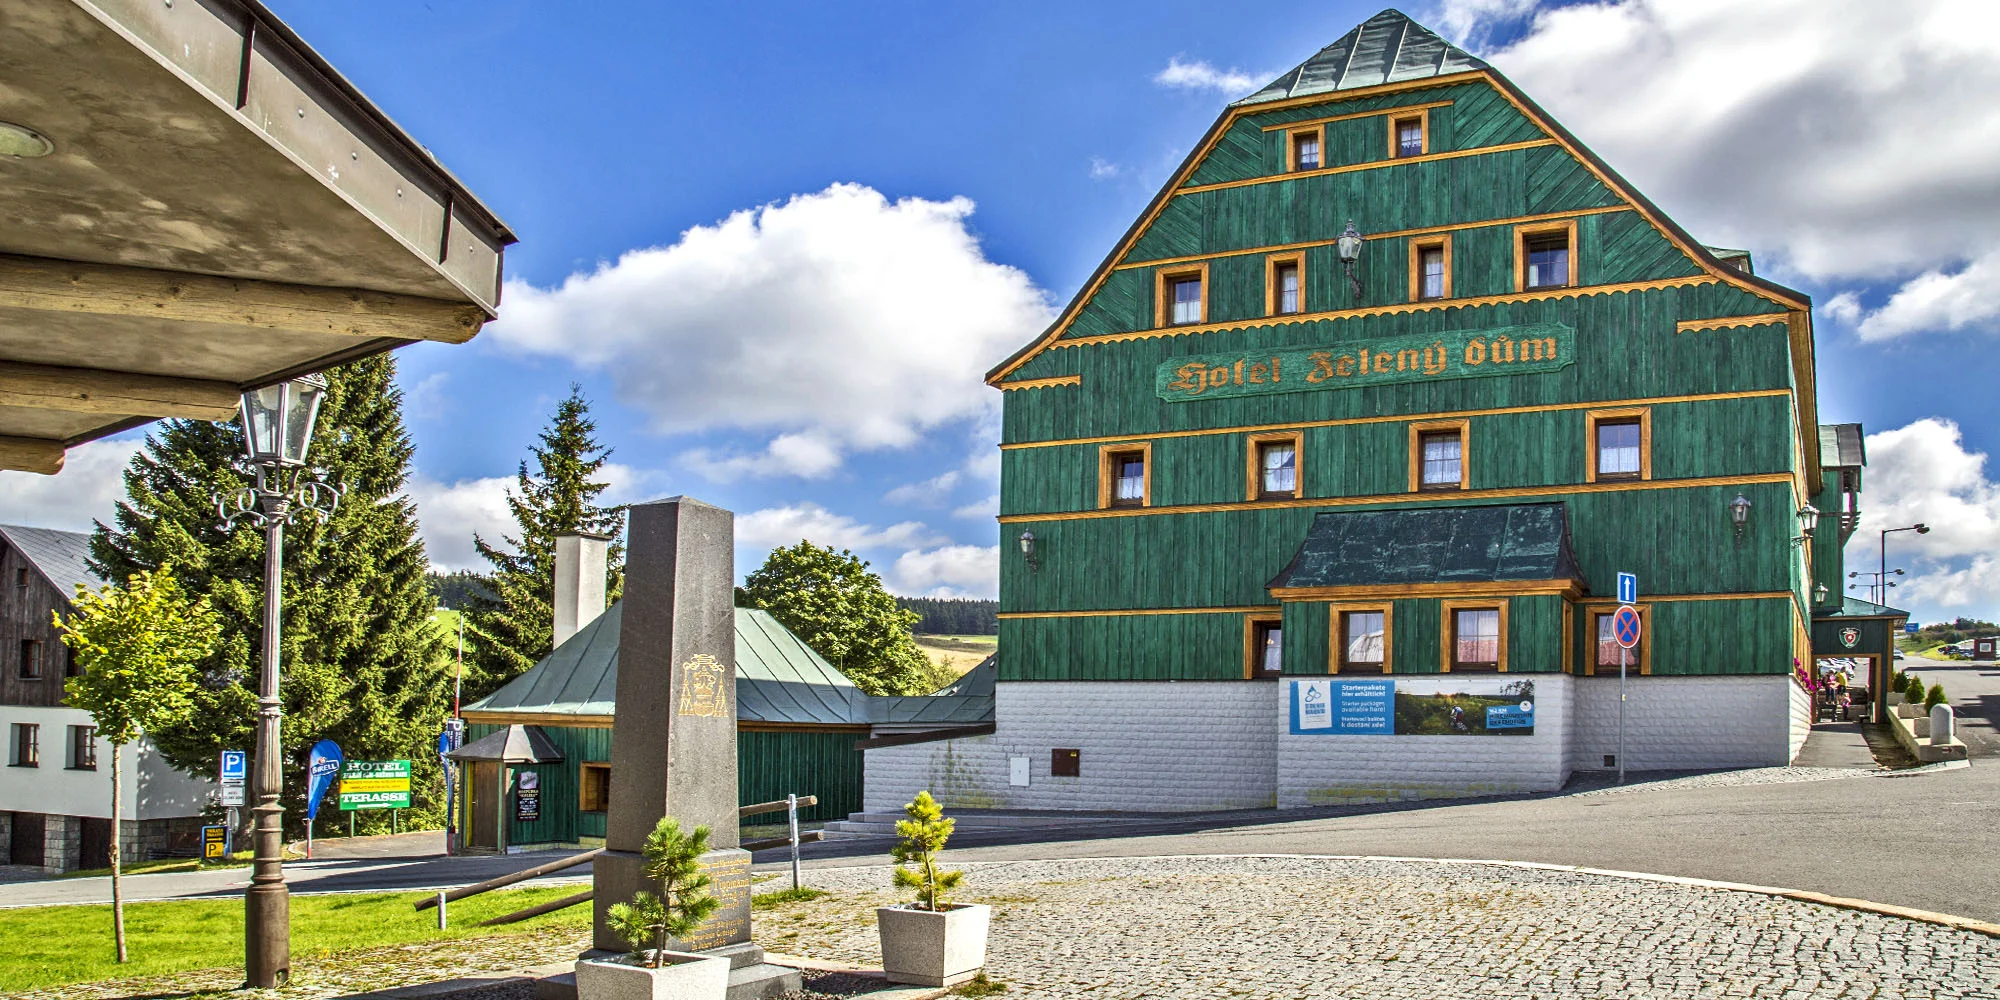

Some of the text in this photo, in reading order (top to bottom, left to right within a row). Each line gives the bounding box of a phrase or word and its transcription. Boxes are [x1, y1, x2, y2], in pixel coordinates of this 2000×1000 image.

[1167, 335, 1557, 395] Hotel Zelený dům
[1341, 684, 1386, 692] Starterpakete
[226, 754, 240, 771] P
[347, 762, 404, 771] HOTEL
[312, 763, 337, 774] BIRELL
[341, 792, 408, 803] TERASSE
[208, 844, 217, 856] P
